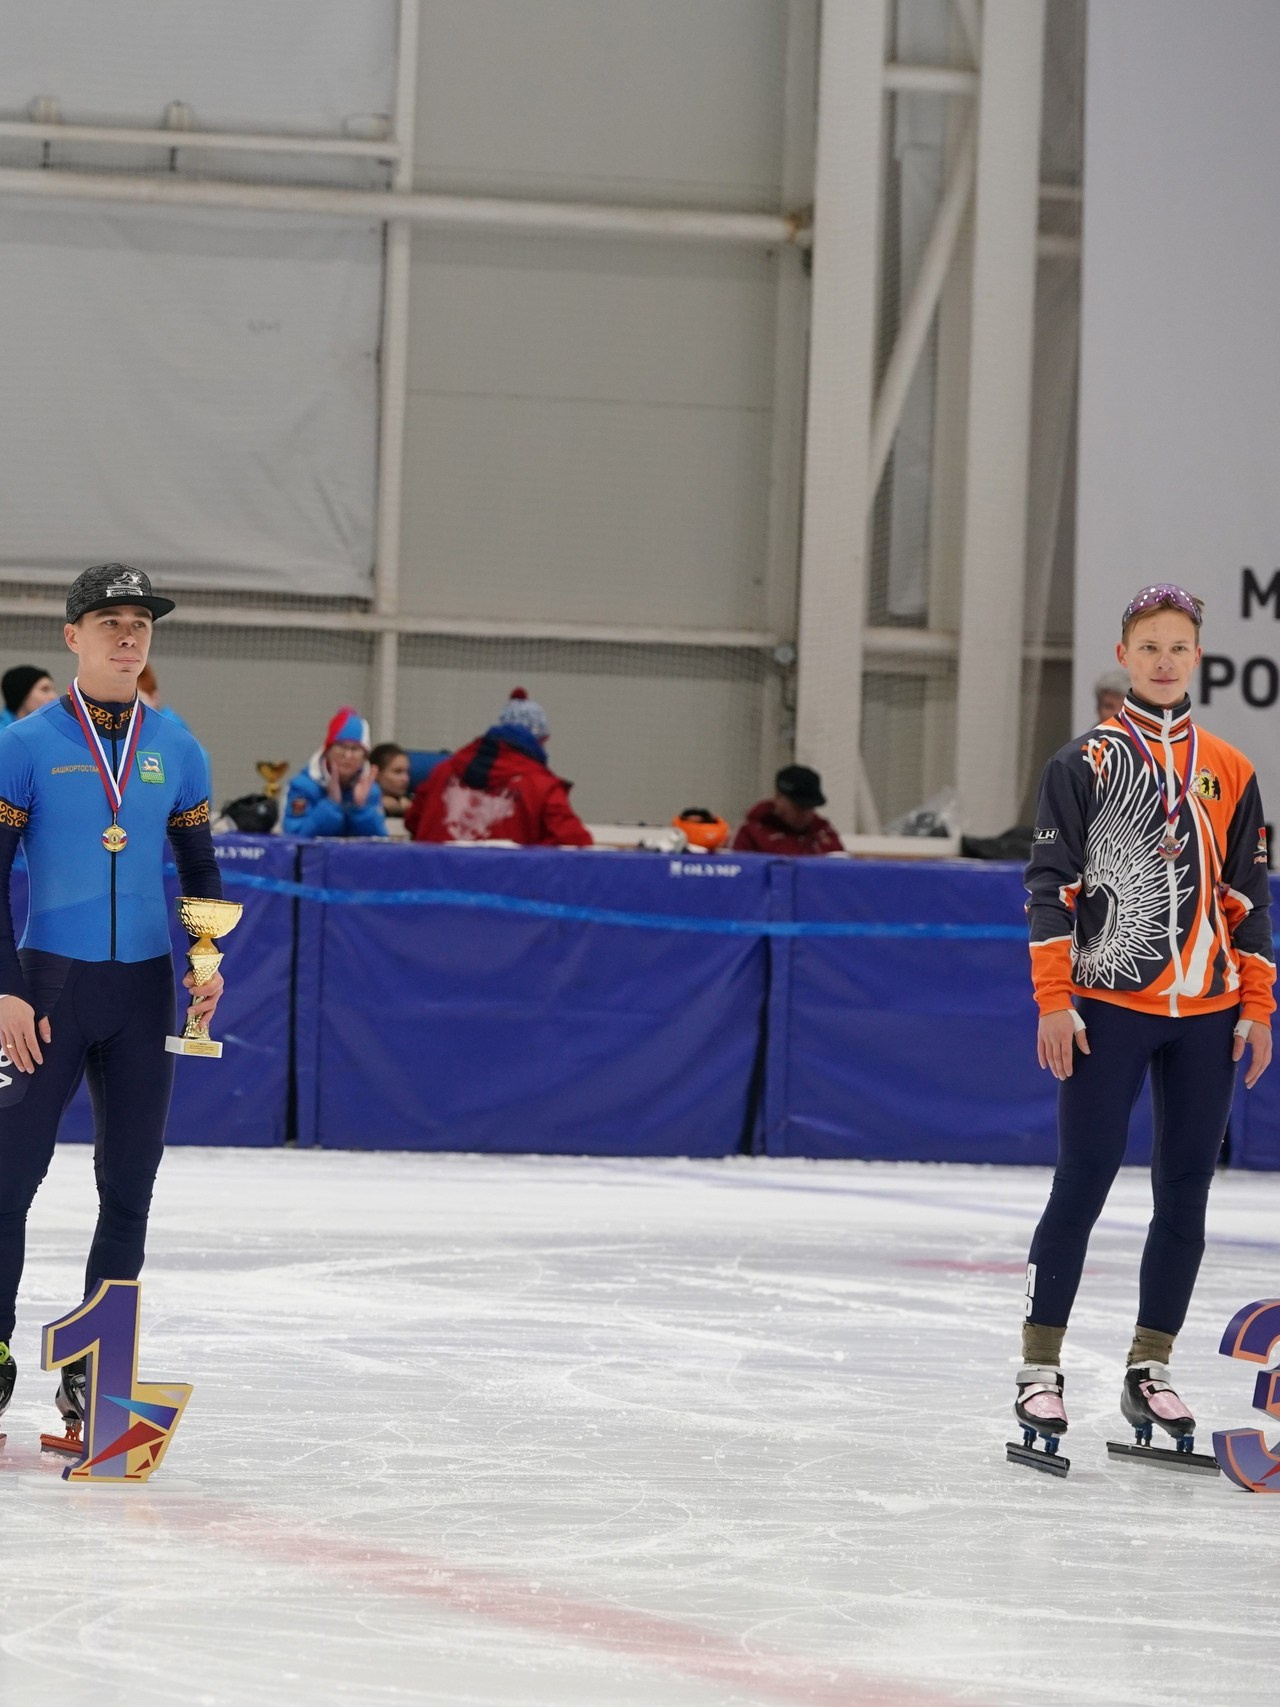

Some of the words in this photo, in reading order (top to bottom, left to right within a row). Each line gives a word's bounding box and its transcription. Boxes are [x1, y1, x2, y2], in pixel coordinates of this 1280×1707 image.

[213, 846, 265, 860] LYMP
[684, 863, 742, 878] OLYMP
[41, 1278, 148, 1481] 1
